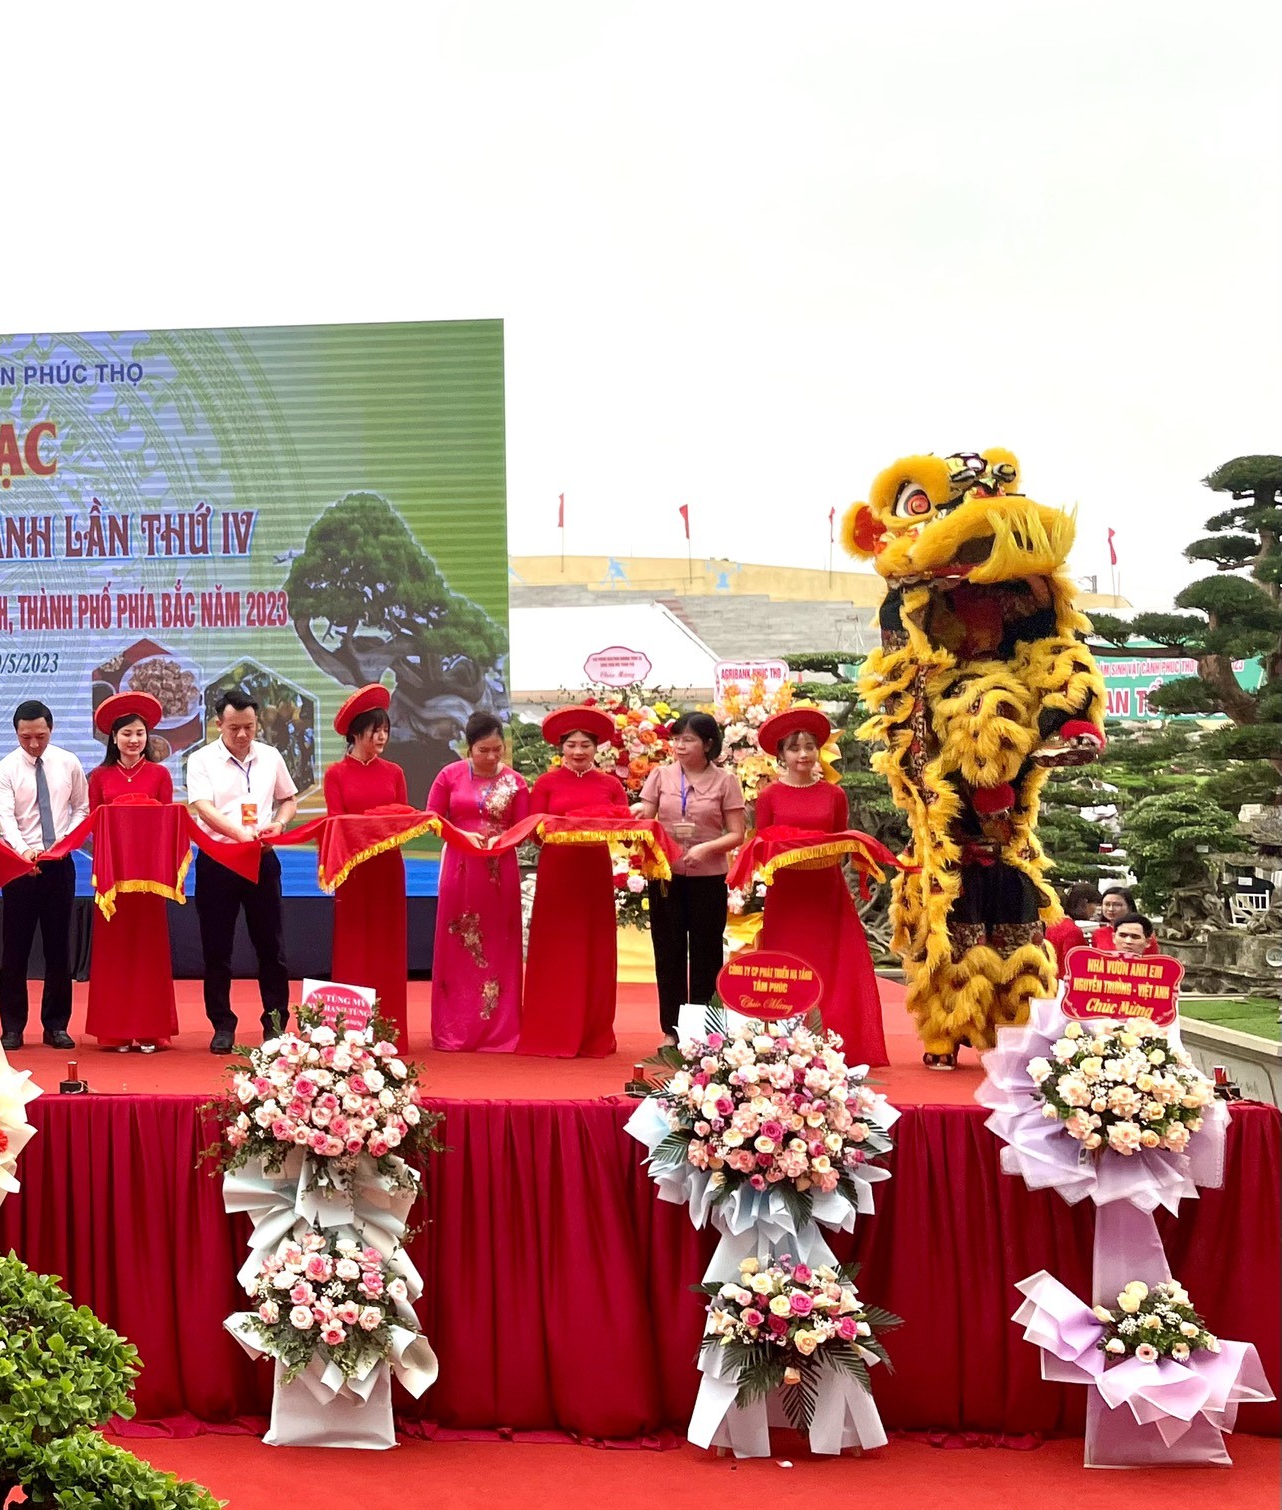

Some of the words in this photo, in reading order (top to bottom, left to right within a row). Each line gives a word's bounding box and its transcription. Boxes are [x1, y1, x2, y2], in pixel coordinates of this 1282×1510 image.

[24, 360, 87, 385] PHÚC
[95, 363, 143, 386] THỌ
[65, 497, 130, 557] LẦN
[141, 502, 212, 556] THỨ
[222, 512, 255, 554] IV
[18, 587, 73, 630] THÀNH
[78, 581, 112, 629] PHỐ
[117, 586, 157, 629] PHÍA
[161, 579, 196, 627] BẮC
[201, 584, 241, 627] NĂM
[246, 591, 289, 627] 2023
[721, 668, 751, 680] AGRIBANK
[1087, 957, 1105, 973] NHÀ
[1106, 958, 1129, 976] VƯỜN
[1130, 962, 1148, 978] ANH
[1149, 964, 1164, 979] EM
[1138, 982, 1153, 1001] VIỆT
[1154, 985, 1170, 999] ANH
[1086, 997, 1118, 1014] Chúc
[1118, 1001, 1155, 1019] Mừng
